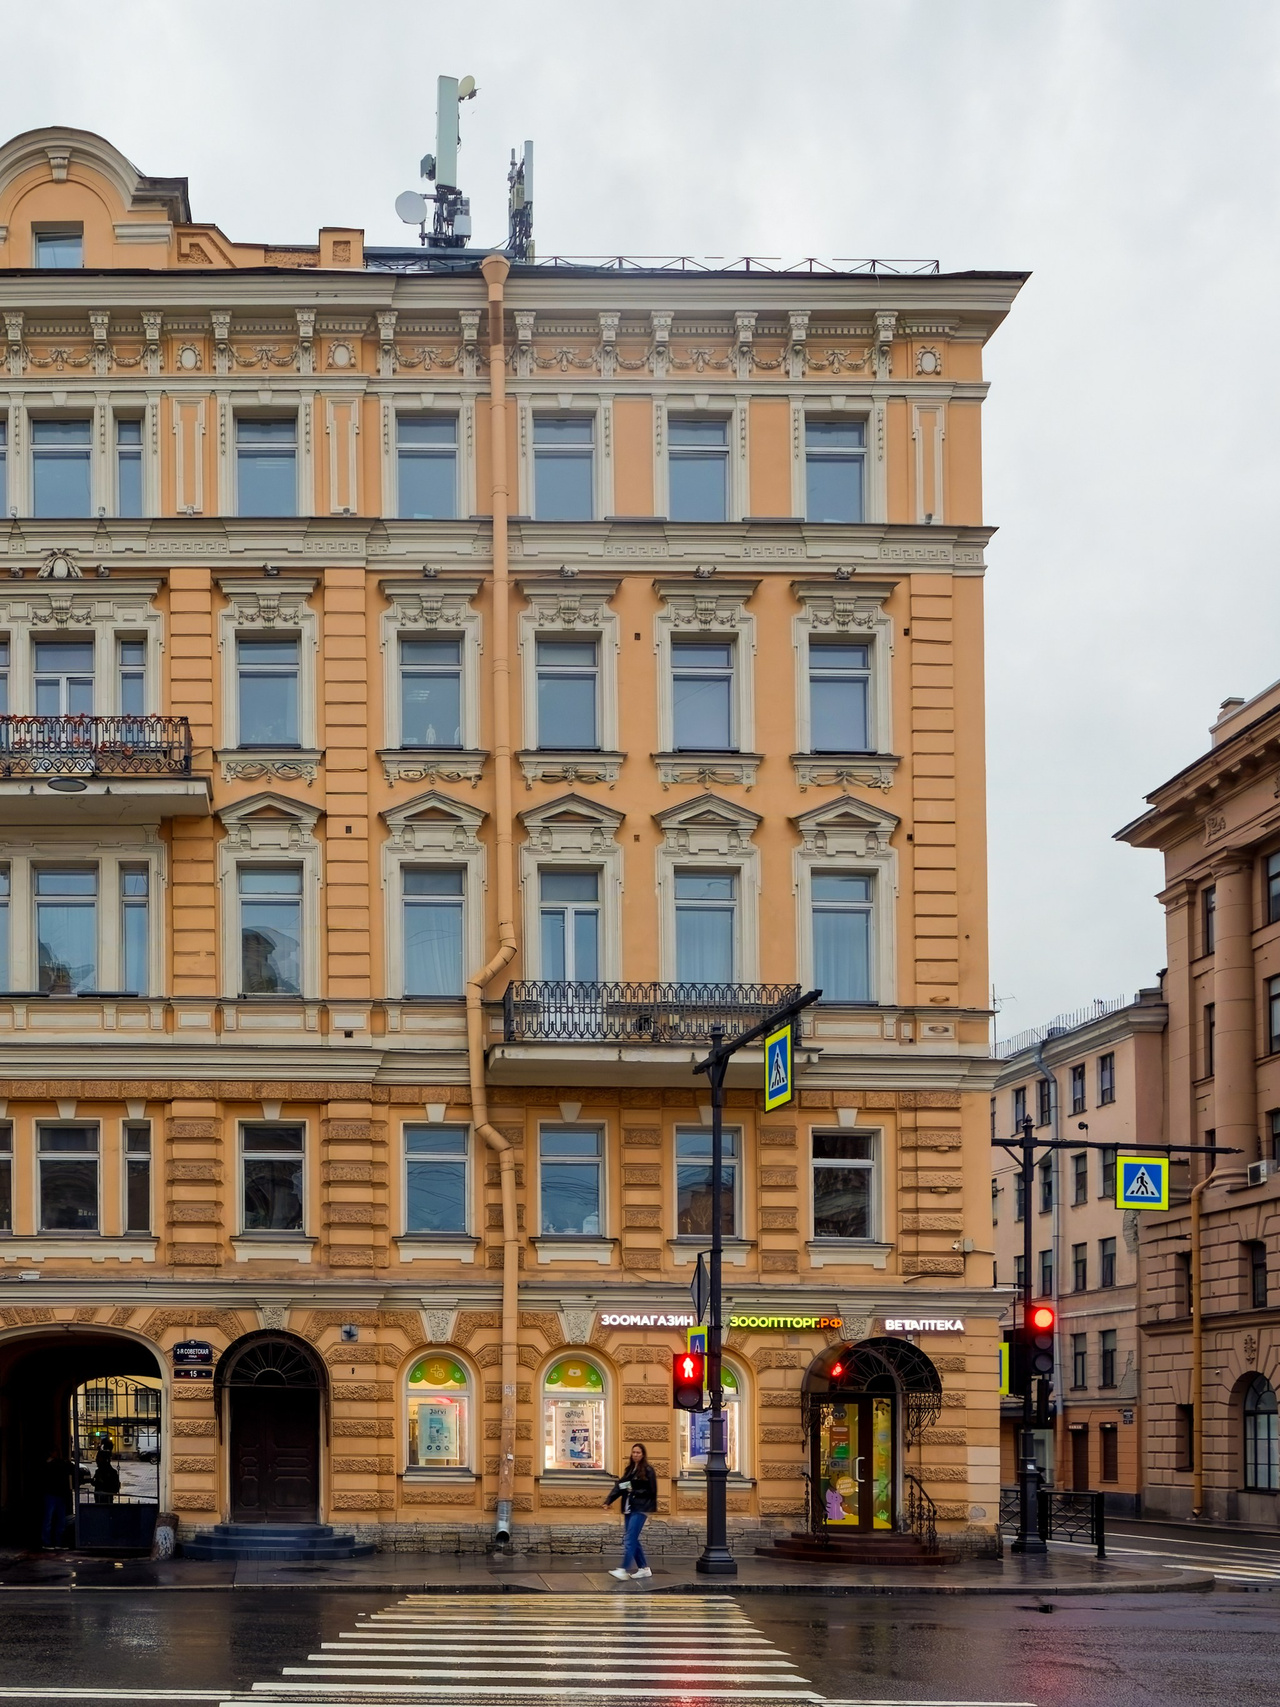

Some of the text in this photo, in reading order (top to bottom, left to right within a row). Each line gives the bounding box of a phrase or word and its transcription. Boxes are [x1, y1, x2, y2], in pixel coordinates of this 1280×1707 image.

[601, 1314, 694, 1327] ЗООМАГАЗИН
[729, 1316, 843, 1329] ЗОООПТТОРГ.РФ
[884, 1319, 965, 1331] ВЕТАПТЕКА
[189, 1370, 198, 1378] 15
